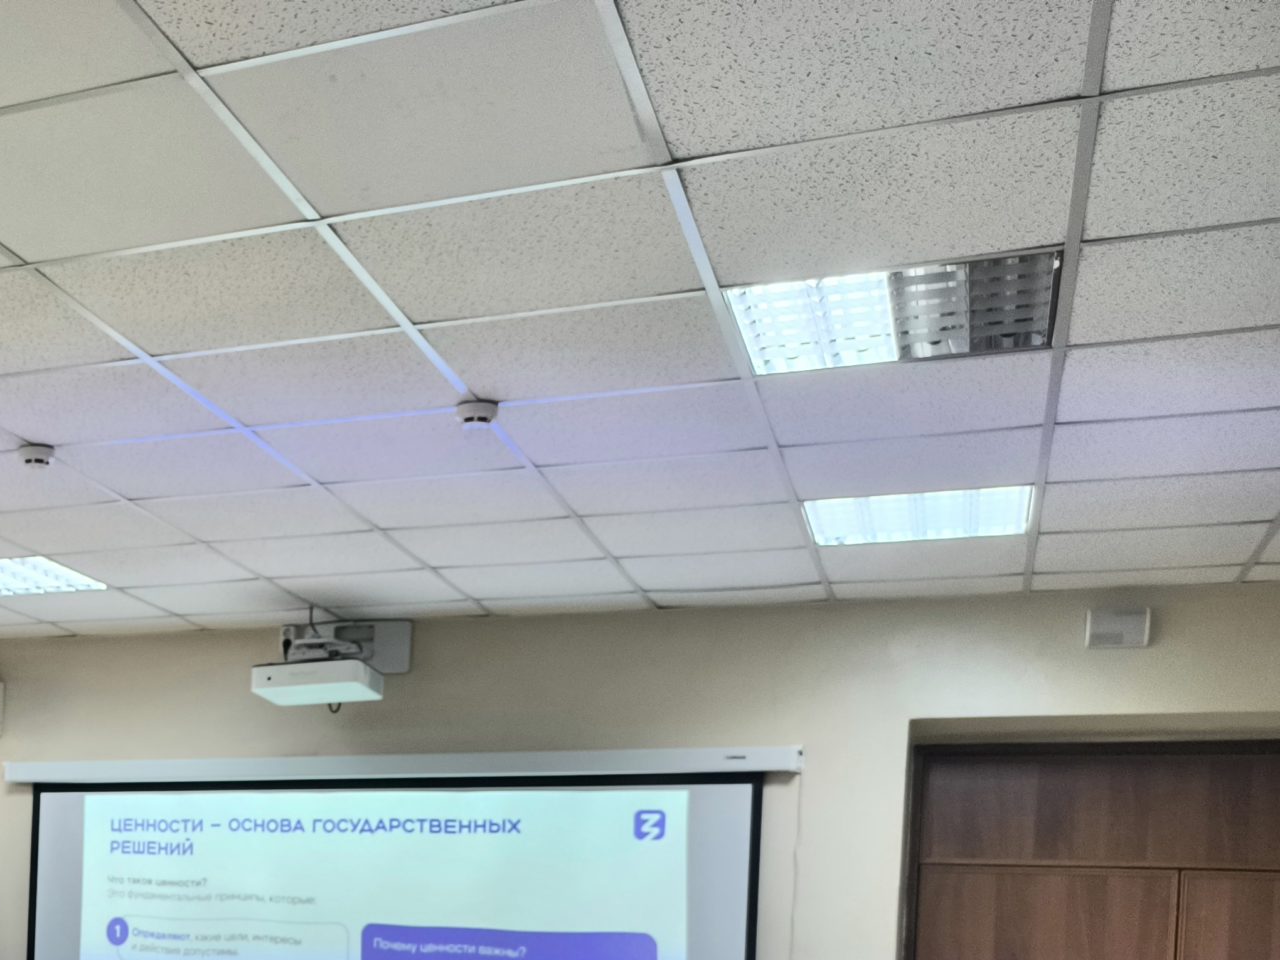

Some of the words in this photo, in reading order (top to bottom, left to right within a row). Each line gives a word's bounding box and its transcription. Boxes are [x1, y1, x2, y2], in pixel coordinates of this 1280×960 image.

[110, 818, 204, 834] ЦЕННОСТИ
[228, 818, 306, 833] ОСНОВА
[312, 818, 522, 834] ГОСУДАРСТВЕННЫХ
[110, 838, 194, 856] РЕШЕНИЙ
